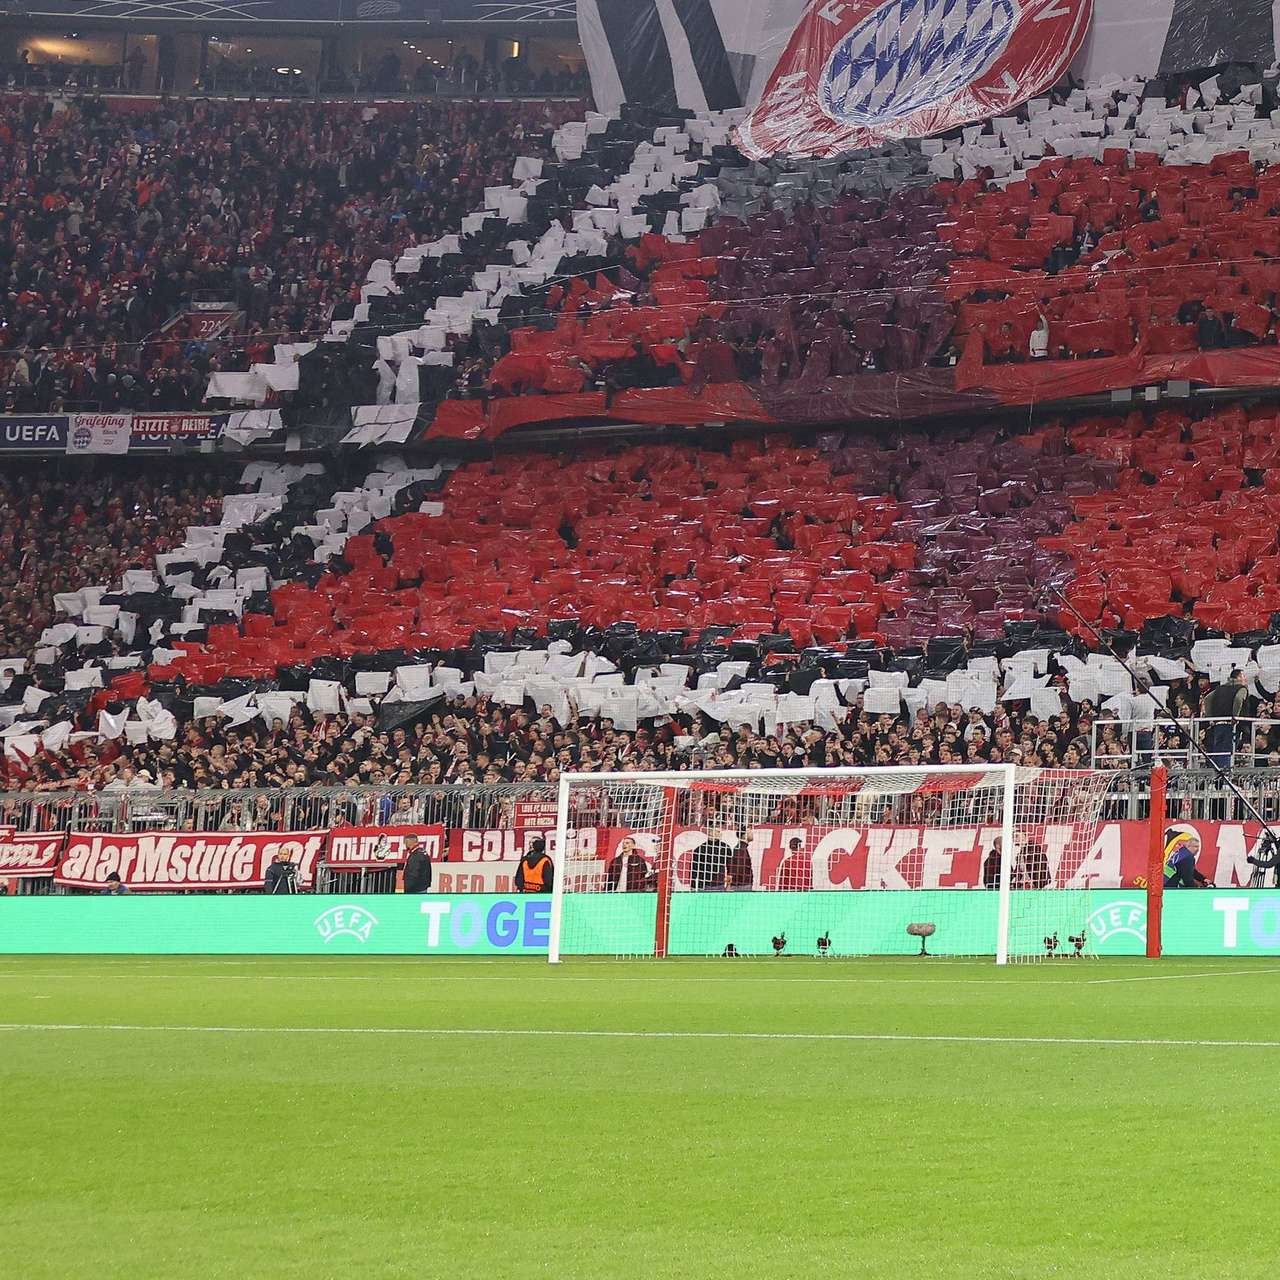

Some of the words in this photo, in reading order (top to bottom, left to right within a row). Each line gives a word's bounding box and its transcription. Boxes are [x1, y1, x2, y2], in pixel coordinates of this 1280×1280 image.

[5, 425, 61, 442] UEFA
[133, 418, 170, 432] LETZTE
[181, 418, 211, 431] REIHE
[316, 910, 373, 940] UEFA
[419, 900, 553, 948] TOGE
[1088, 907, 1148, 935] UEF
